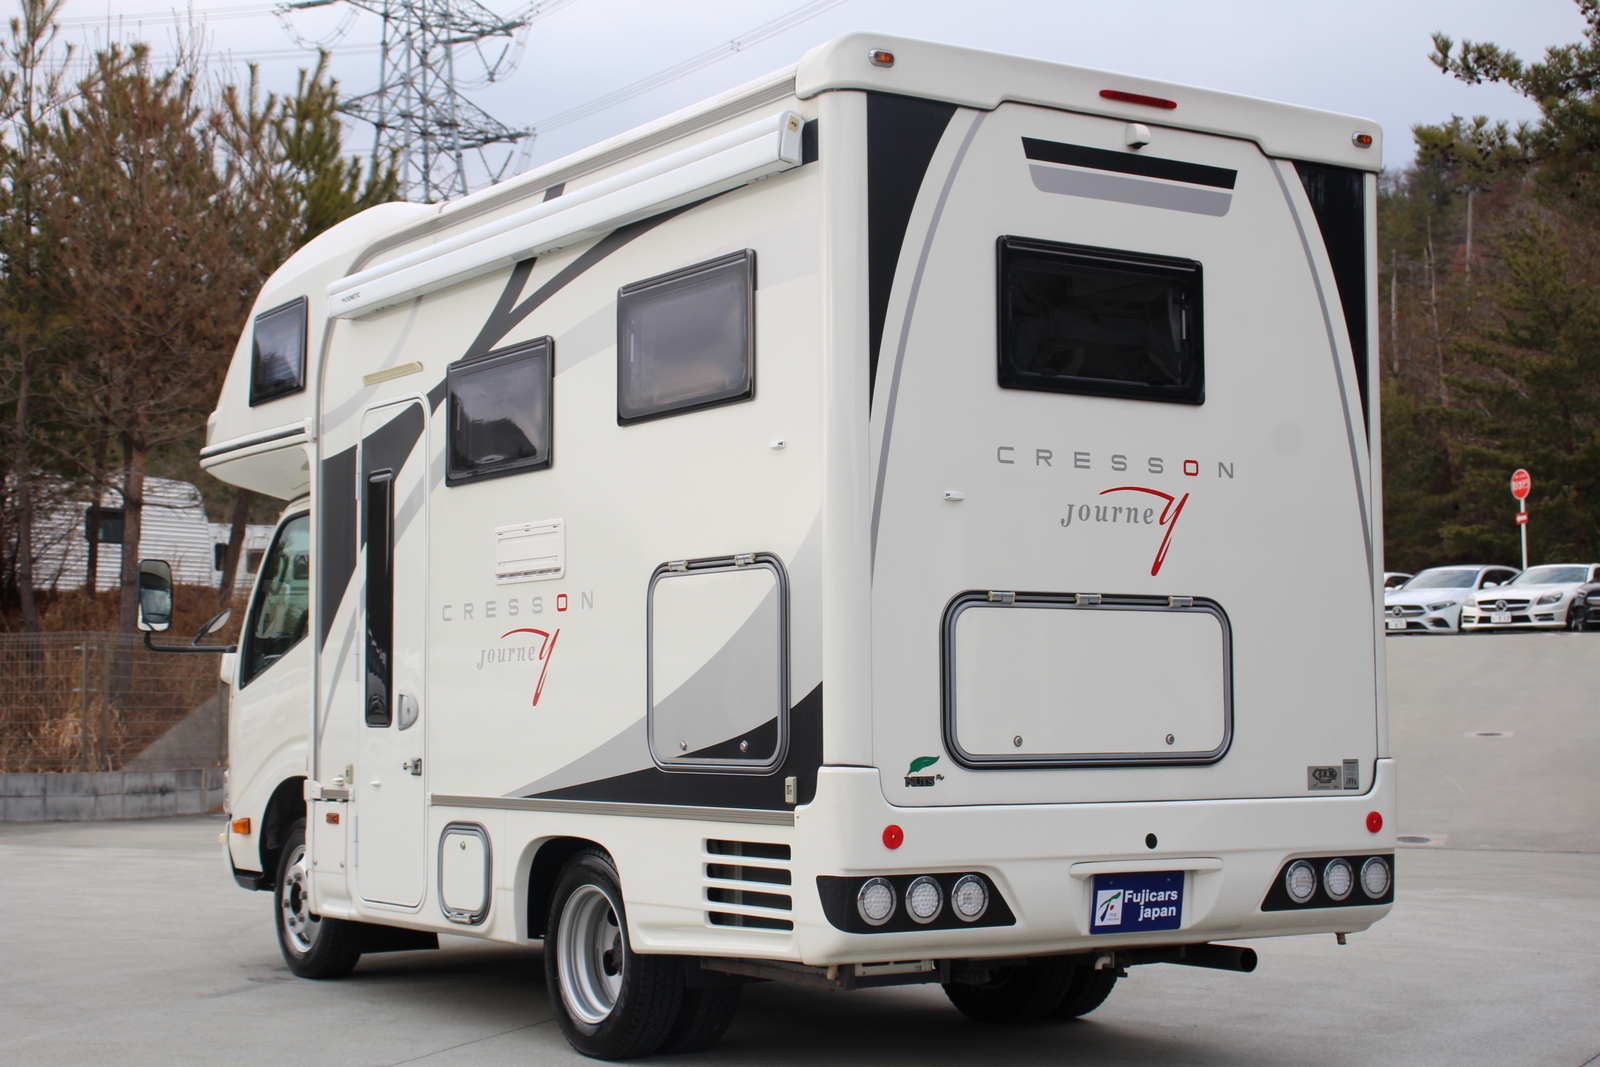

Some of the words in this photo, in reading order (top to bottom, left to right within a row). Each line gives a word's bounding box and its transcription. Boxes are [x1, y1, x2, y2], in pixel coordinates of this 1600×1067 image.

[997, 446, 1234, 479] CRESSON
[442, 590, 594, 622] CRESSON
[1124, 889, 1179, 905] Fujicars
[1137, 905, 1177, 922] japan
